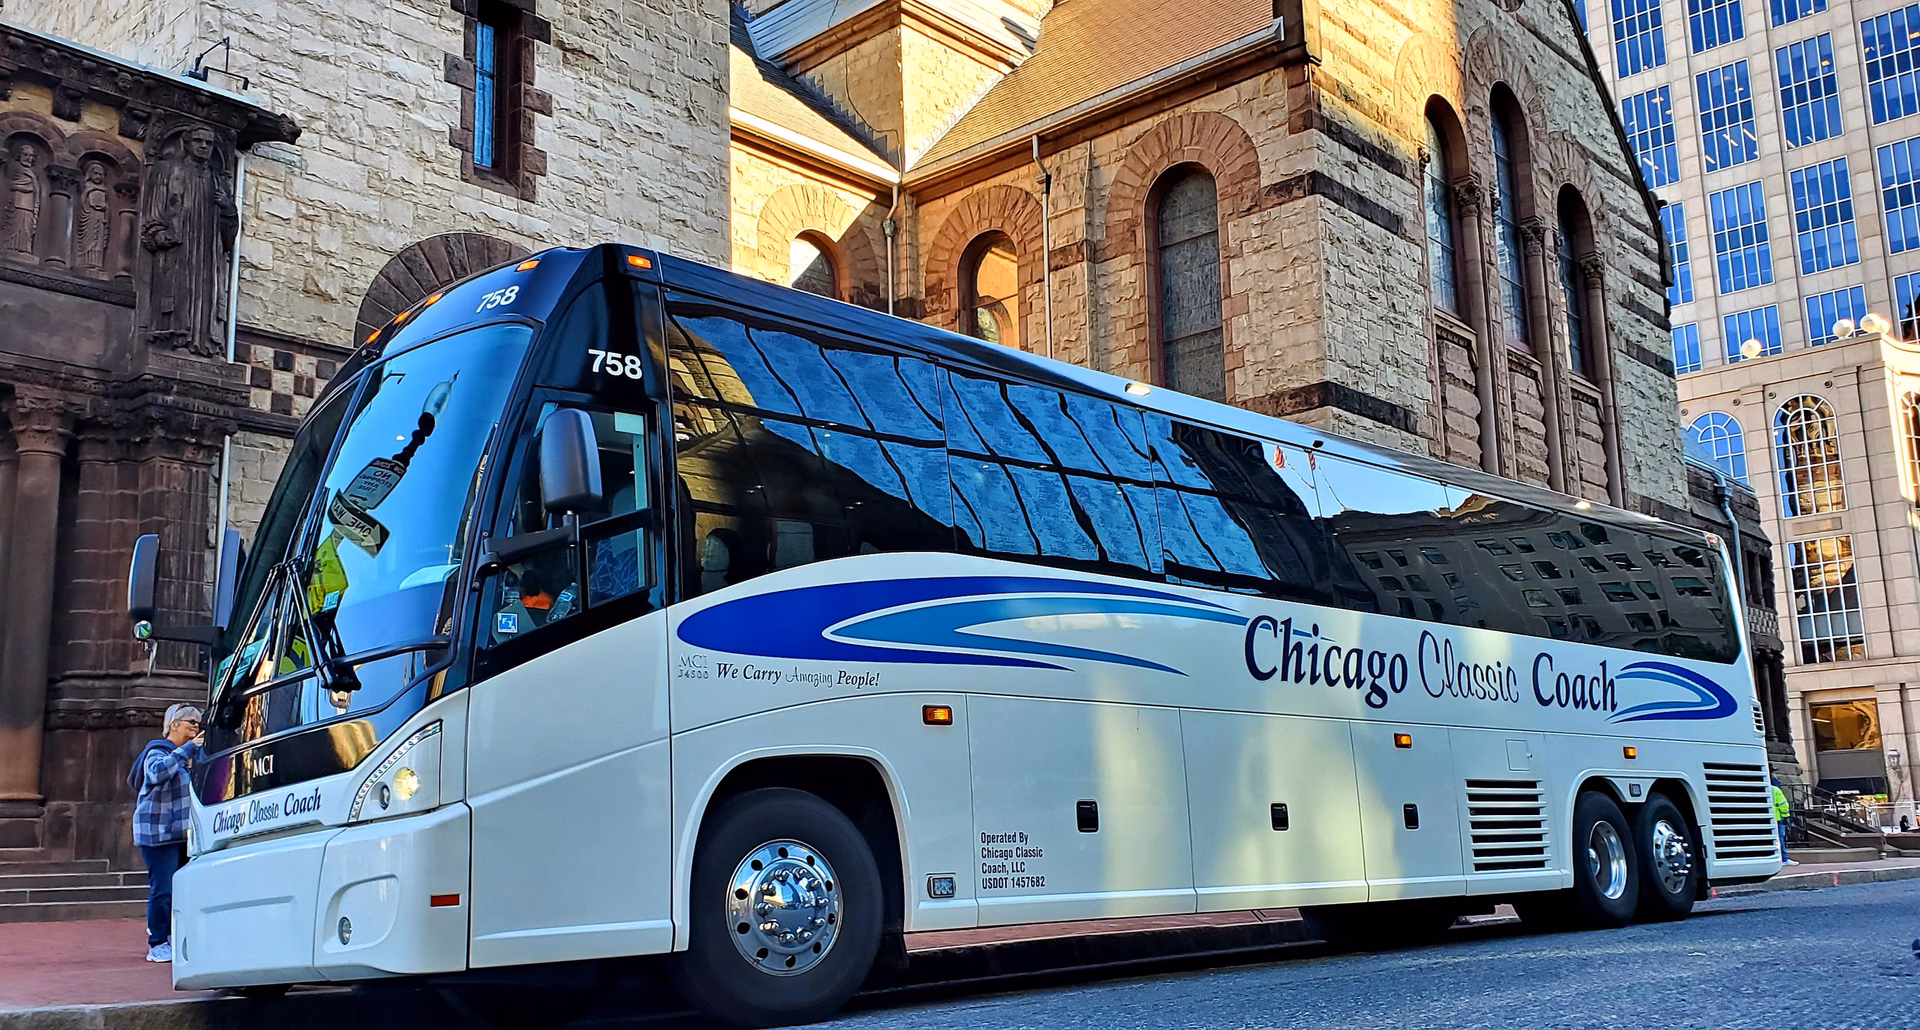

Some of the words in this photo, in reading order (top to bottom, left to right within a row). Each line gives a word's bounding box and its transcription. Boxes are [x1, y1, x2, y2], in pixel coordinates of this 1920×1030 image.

[475, 286, 520, 314] 758
[588, 349, 643, 380] 758
[679, 654, 708, 669] MCI
[1244, 614, 1409, 709] Chicago
[1418, 629, 1520, 704] Classic
[1531, 651, 1618, 713] Coach
[716, 662, 738, 679] We
[743, 664, 781, 685] Carry
[785, 666, 833, 688] Amazing
[836, 670, 880, 689] People!
[252, 754, 274, 779] MCI
[213, 811, 246, 834] Chicago
[248, 799, 280, 825] Classic
[284, 786, 322, 817] Coach
[980, 832, 1017, 846] Operated
[1018, 831, 1029, 845] By
[981, 846, 1014, 861] Chicago
[1015, 845, 1044, 858] Classic
[981, 862, 1010, 875] Coach,
[1011, 861, 1026, 873] LLC
[981, 877, 1009, 890] USDOT
[1010, 875, 1046, 888] 1457682
